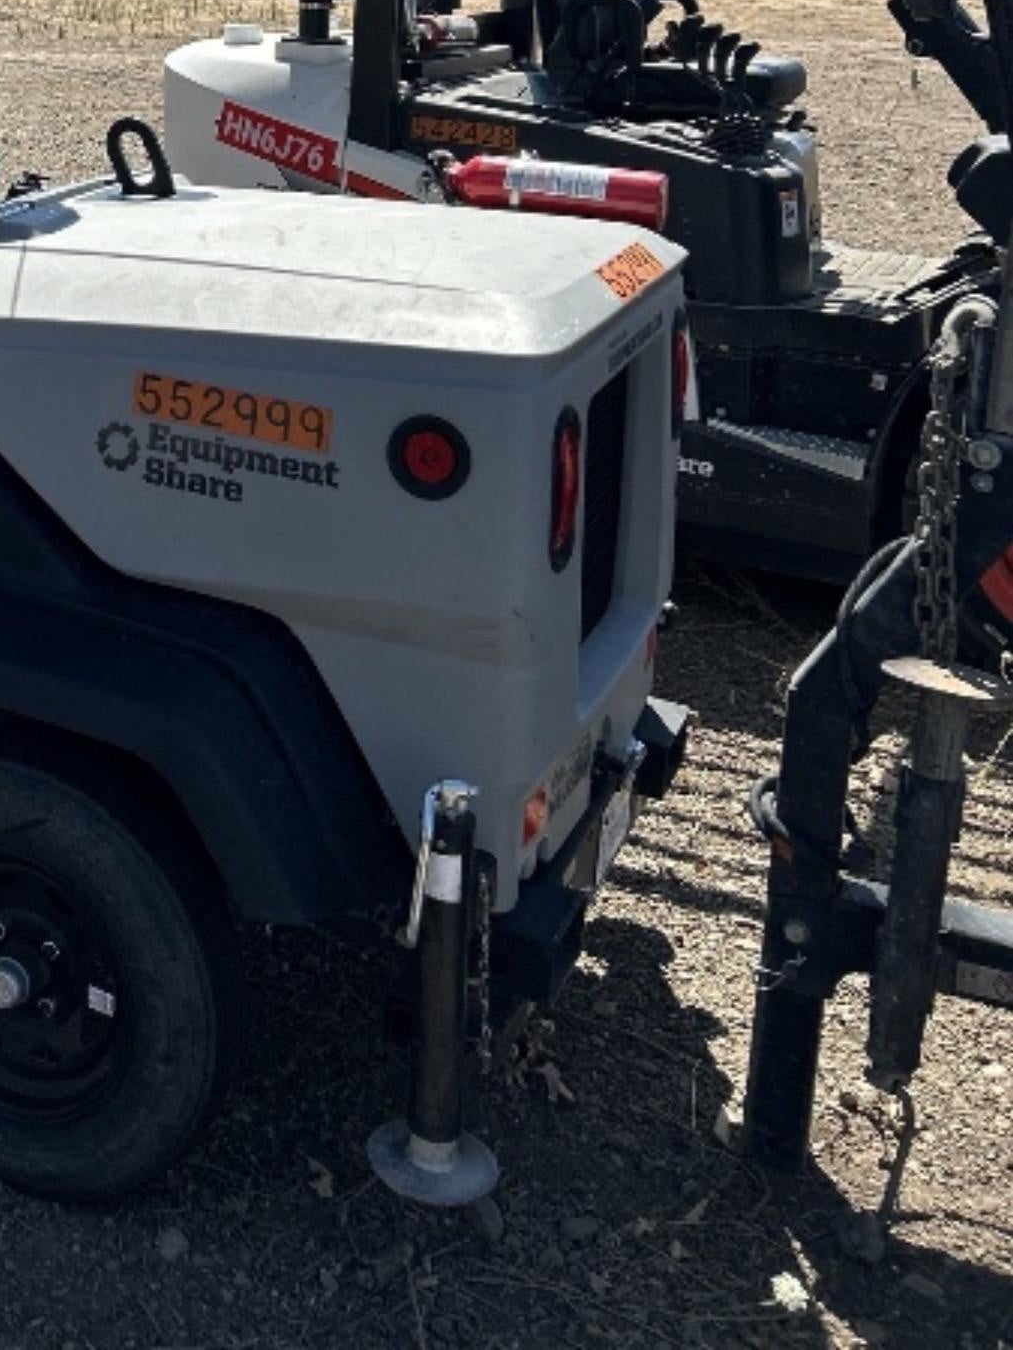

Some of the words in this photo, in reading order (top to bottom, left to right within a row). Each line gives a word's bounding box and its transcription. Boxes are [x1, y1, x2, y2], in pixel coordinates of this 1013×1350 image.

[137, 373, 326, 451] 552999
[142, 458, 244, 503] Share
[145, 421, 341, 490] Equipment
[677, 455, 715, 478] are
